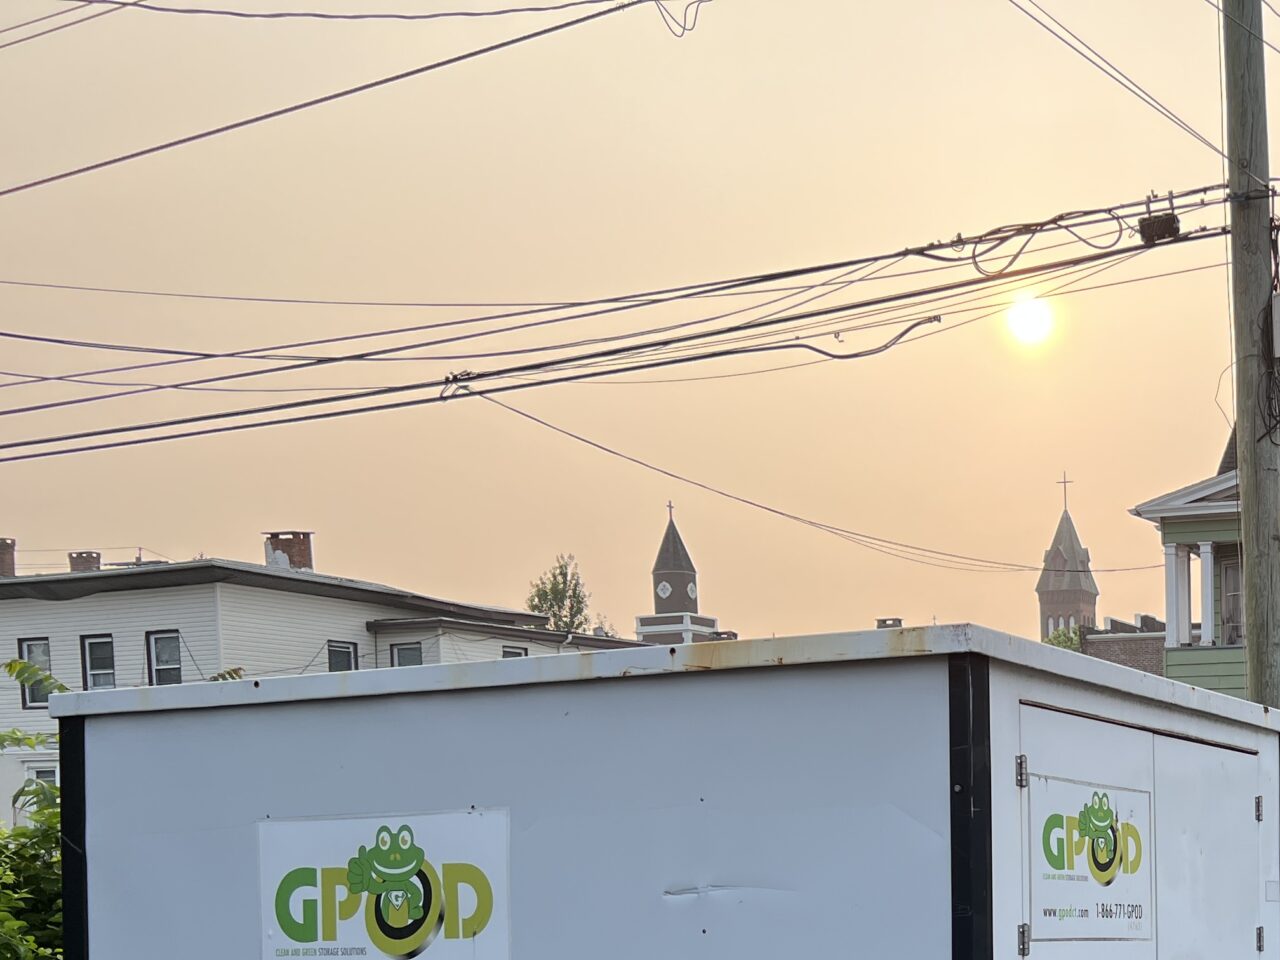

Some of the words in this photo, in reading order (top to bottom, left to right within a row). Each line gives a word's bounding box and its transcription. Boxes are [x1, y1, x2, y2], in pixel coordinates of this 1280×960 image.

[1042, 813, 1142, 887] GPOD
[274, 858, 494, 960] GPOD
[1096, 903, 1143, 919] 1-866-771-GPOD
[318, 947, 339, 956] STORAGE
[340, 947, 367, 956] SOLUTIONS
